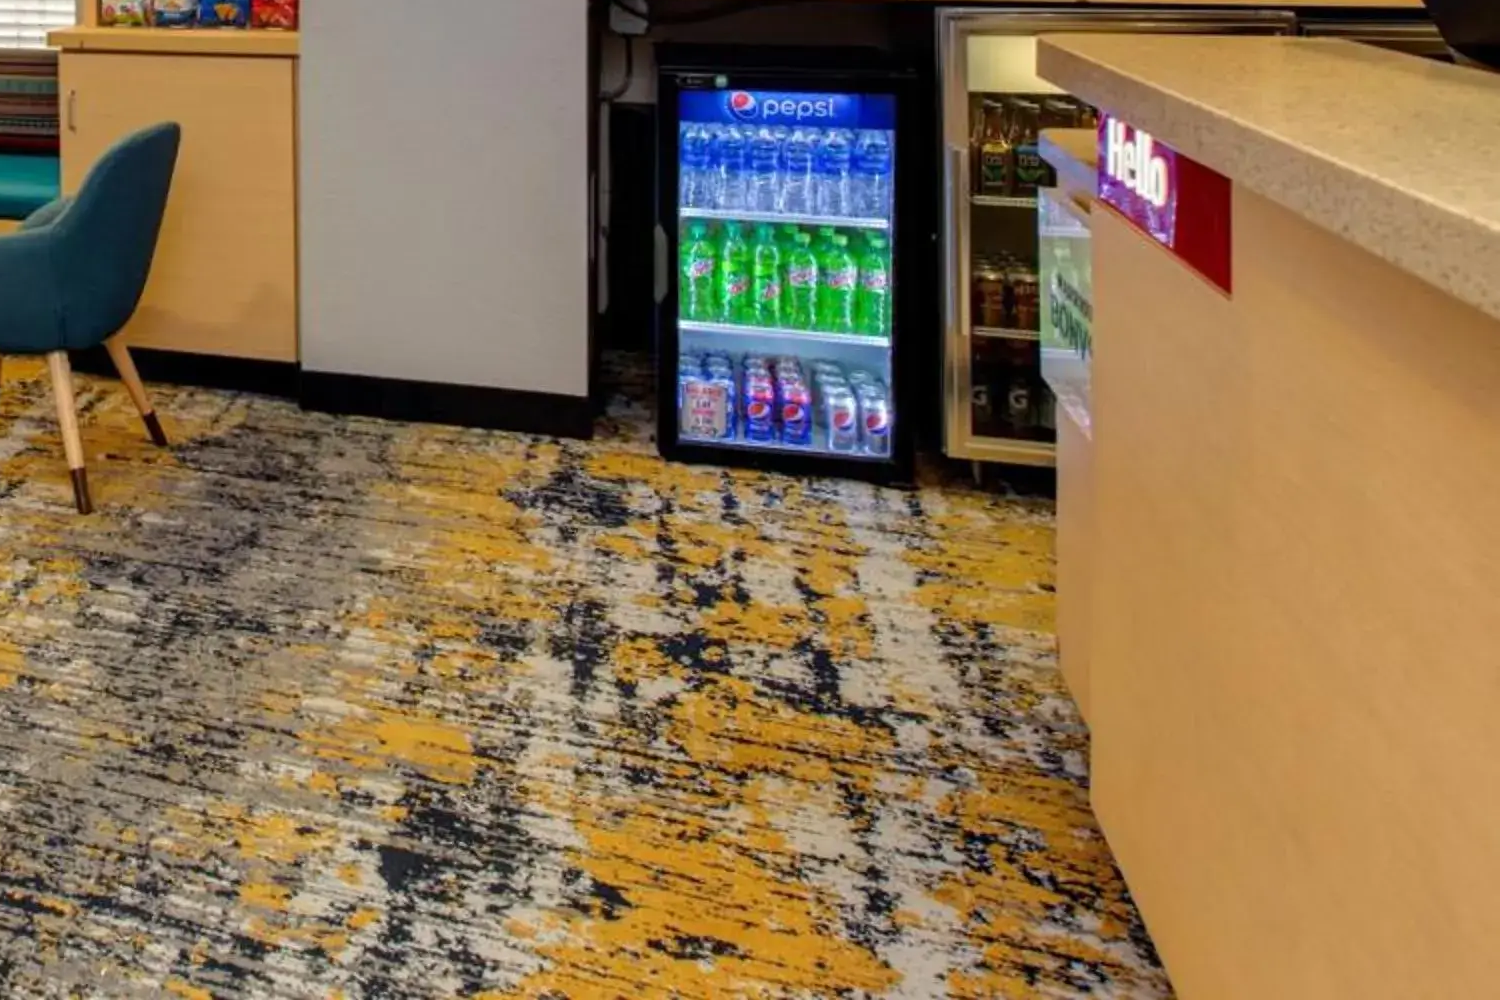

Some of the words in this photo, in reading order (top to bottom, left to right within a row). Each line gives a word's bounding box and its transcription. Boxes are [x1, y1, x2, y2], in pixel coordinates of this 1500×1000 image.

[762, 97, 834, 120] pepsi
[1107, 118, 1169, 207] Hello
[1009, 388, 1028, 408] G
